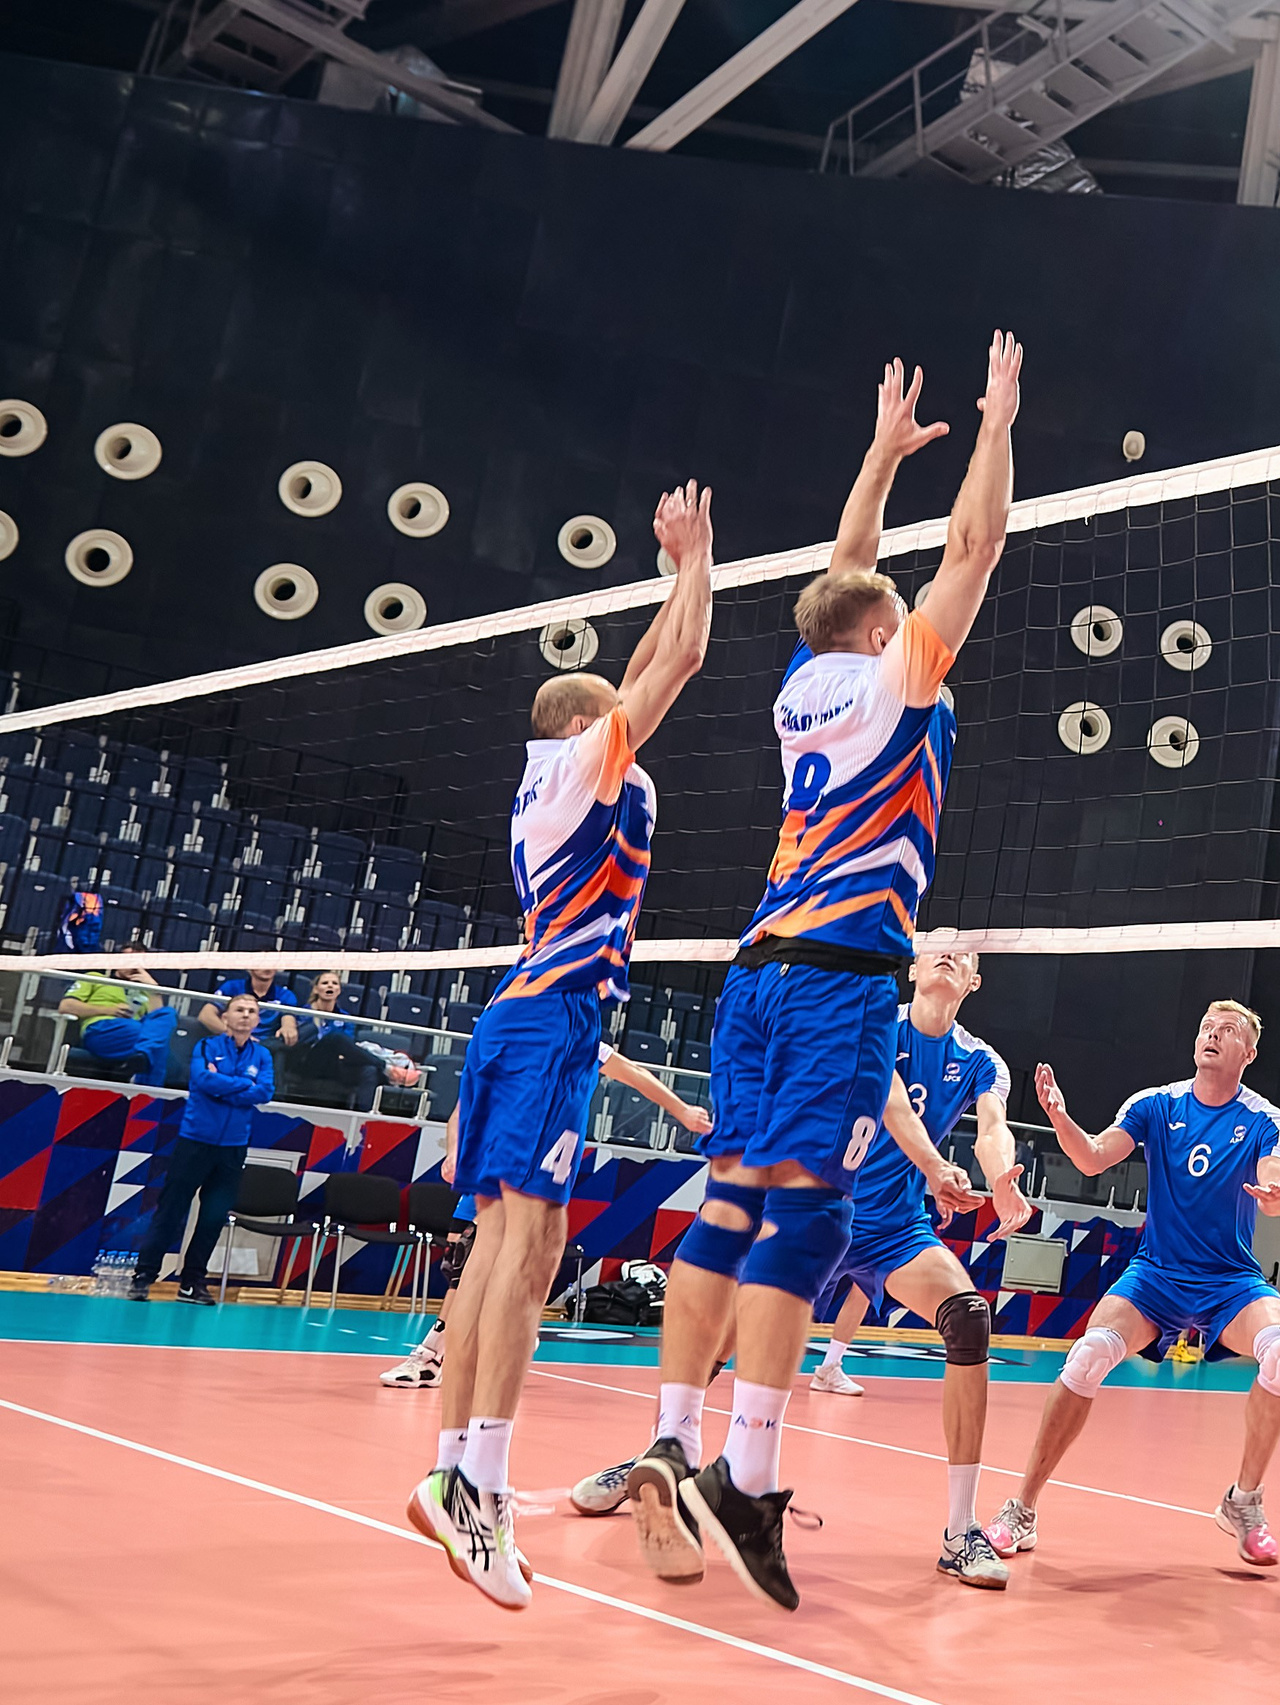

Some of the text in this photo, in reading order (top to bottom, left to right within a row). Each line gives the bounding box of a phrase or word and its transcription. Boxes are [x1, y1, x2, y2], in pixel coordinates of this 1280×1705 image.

[908, 1083, 928, 1118] 3
[539, 1129, 579, 1184] 4
[842, 1116, 876, 1171] 8
[1187, 1143, 1212, 1177] 6
